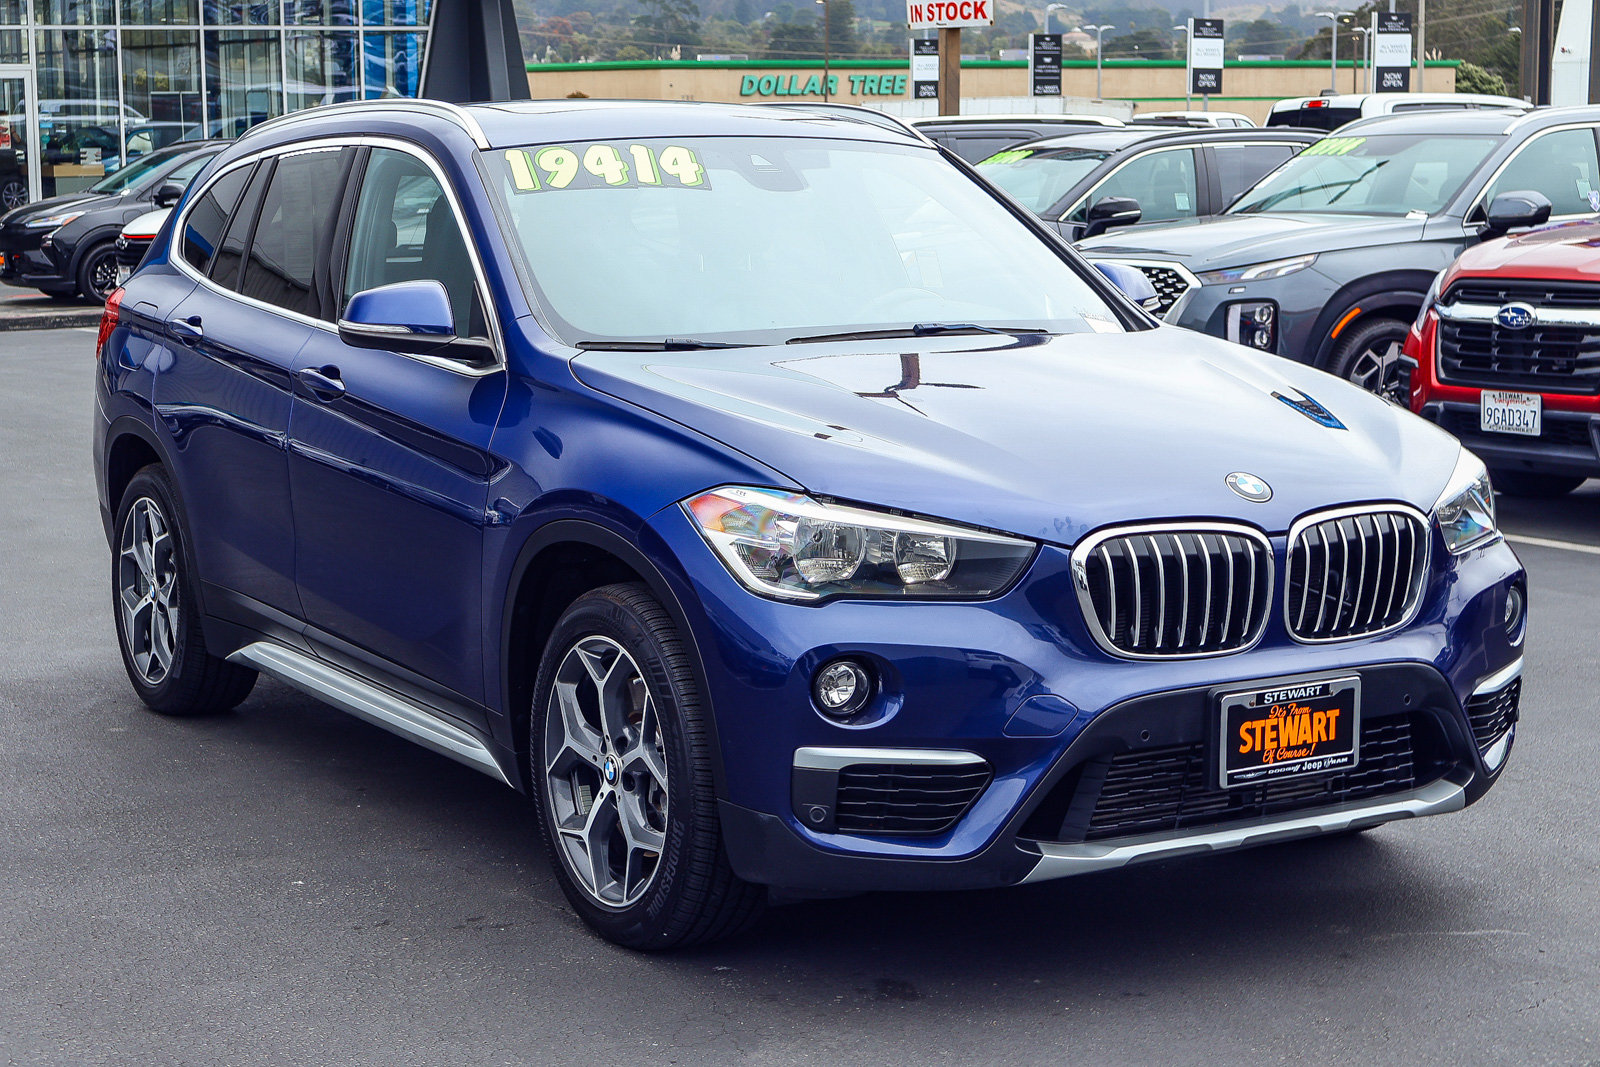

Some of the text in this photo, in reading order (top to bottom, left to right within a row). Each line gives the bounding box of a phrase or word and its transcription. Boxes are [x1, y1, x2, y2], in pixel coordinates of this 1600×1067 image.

[910, 1, 988, 23] IN STOCK
[740, 75, 908, 96] DOLLAR TREE
[1383, 72, 1402, 80] NOW
[504, 144, 705, 191] 19414
[1486, 407, 1537, 428] 9GAD347
[1263, 685, 1322, 704] STEWART
[1268, 702, 1312, 719] It's From
[1239, 708, 1340, 754] STEWART
[1262, 748, 1275, 765] Of
[1302, 760, 1322, 771] Jeep
[646, 818, 685, 919] BRIDGESTONE
